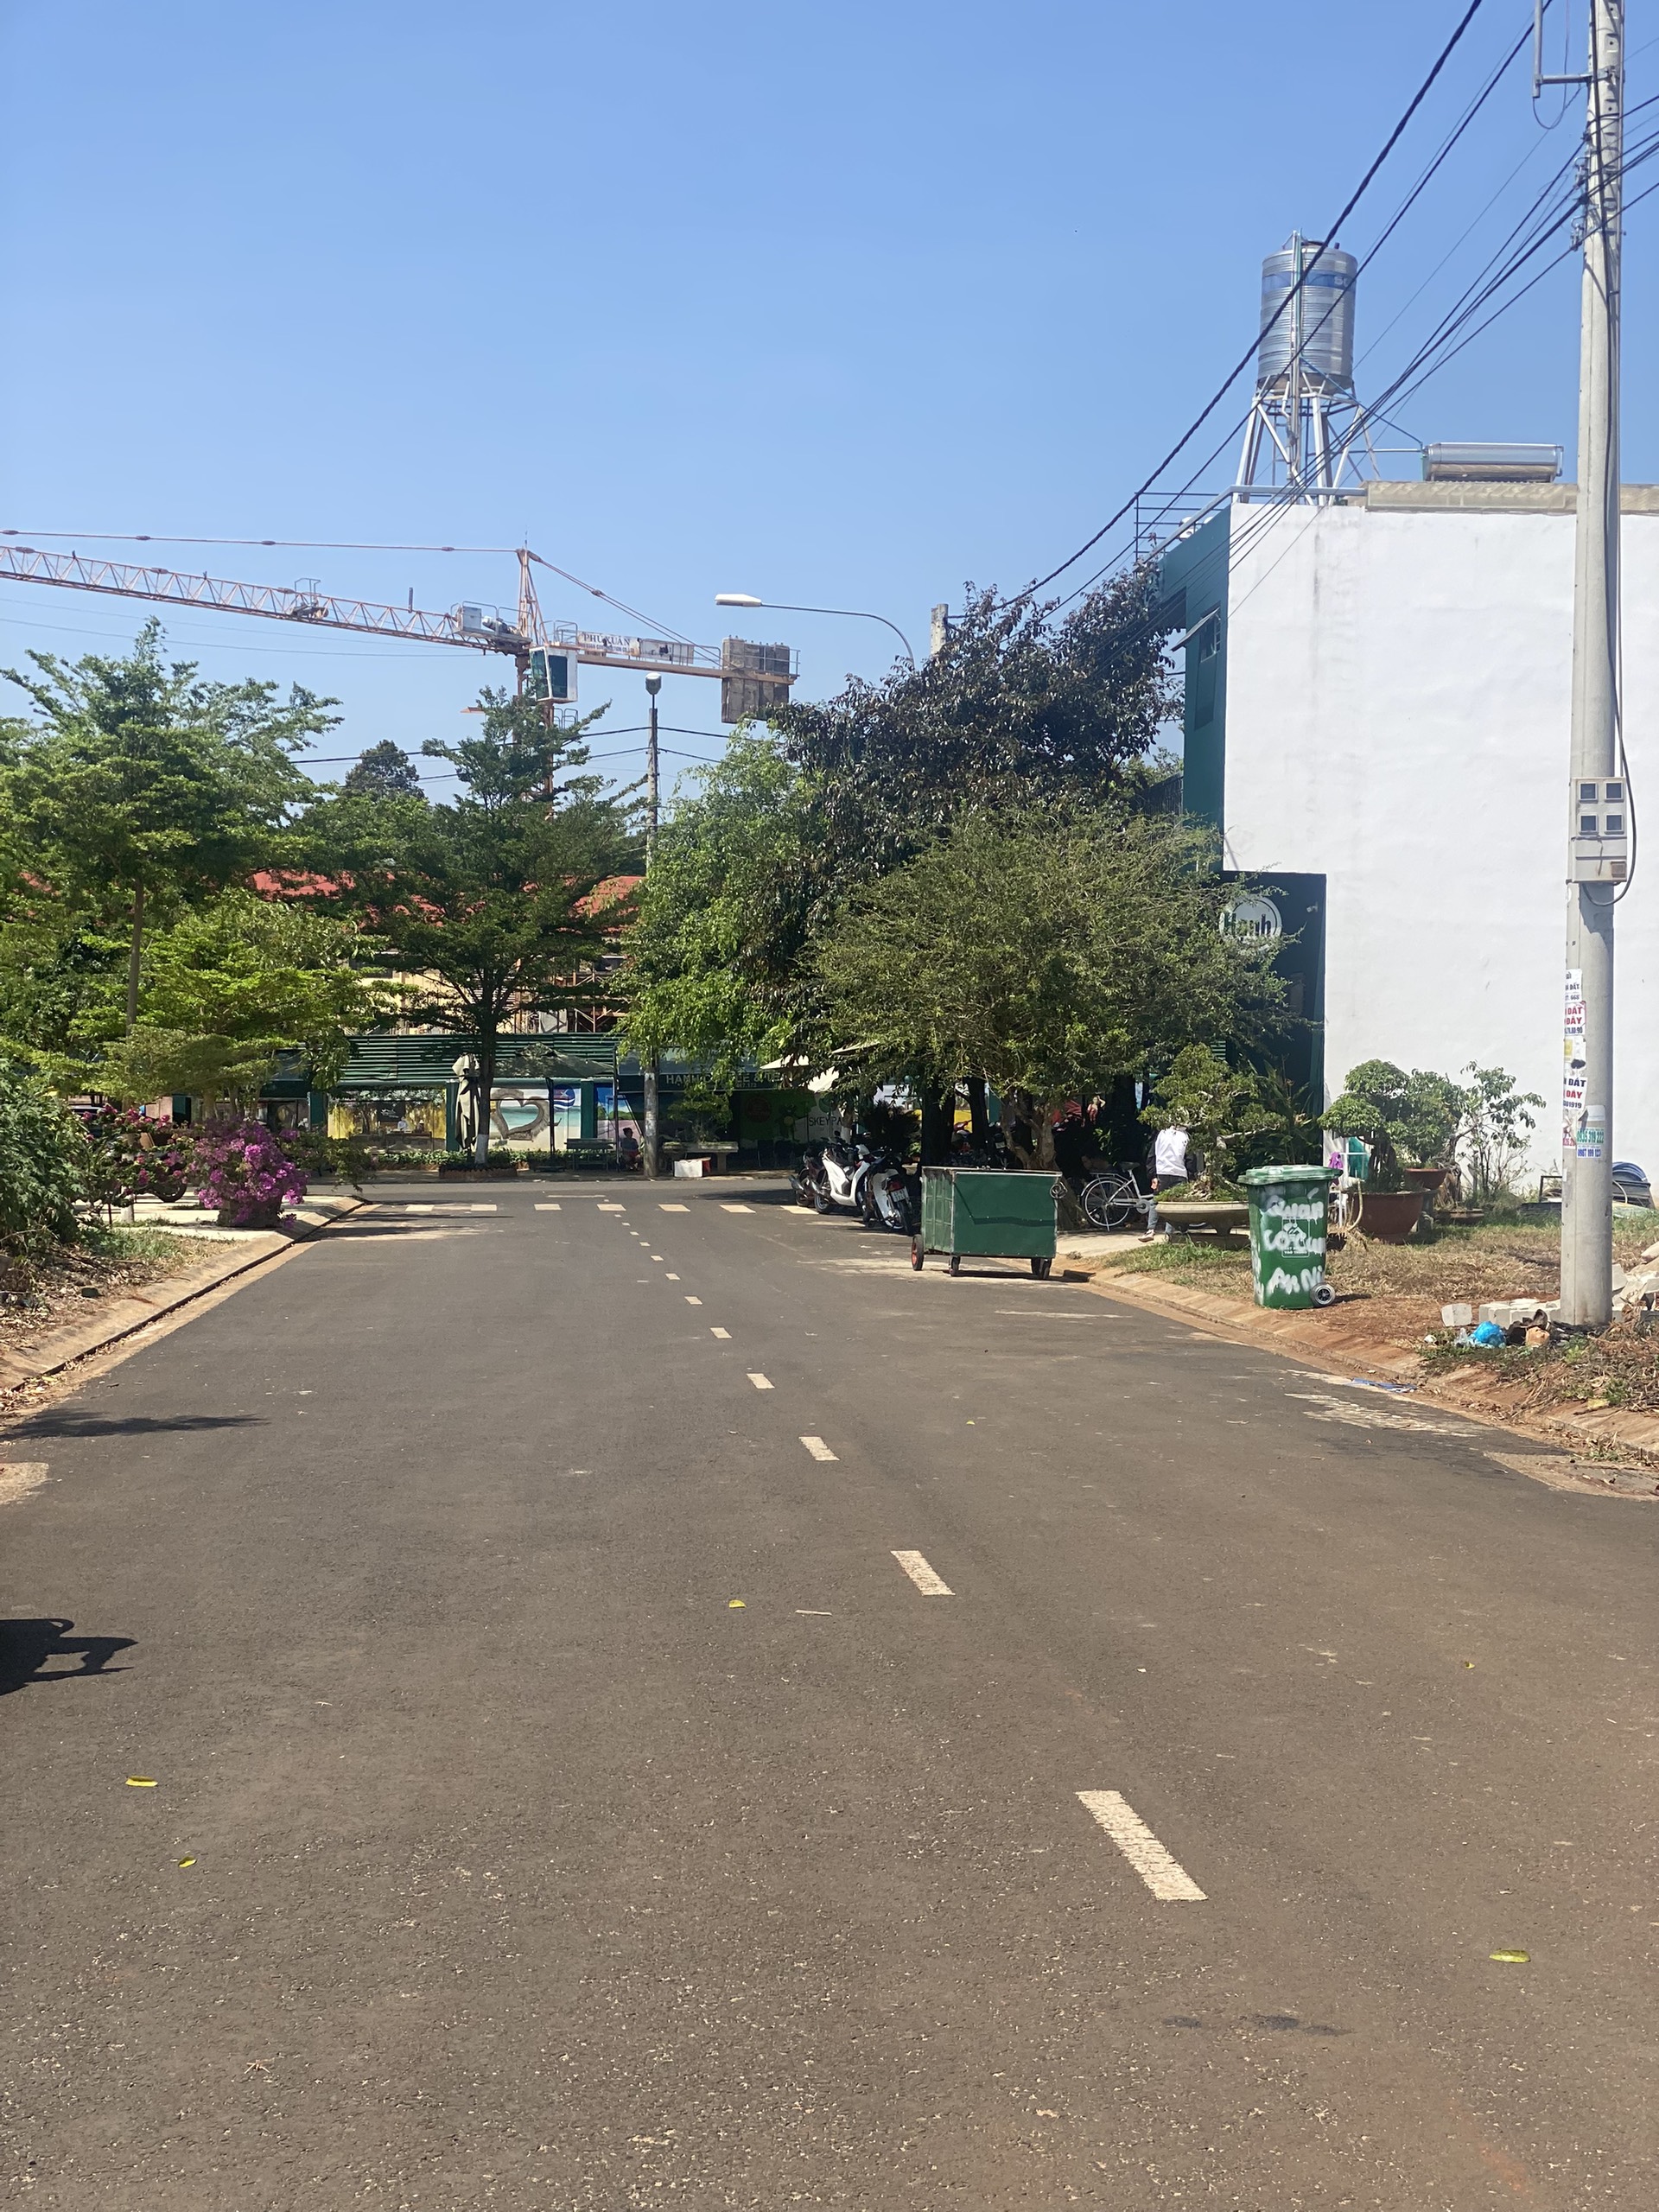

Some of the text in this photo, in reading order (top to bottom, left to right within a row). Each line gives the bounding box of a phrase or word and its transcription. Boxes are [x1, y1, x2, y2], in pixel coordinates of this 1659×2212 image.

[583, 631, 630, 646] PHÚ XUÂN
[1567, 1005, 1582, 1015] ĐẤT
[1566, 1015, 1582, 1026] ĐÂY
[1568, 1077, 1586, 1087] ĐẤT
[1566, 1089, 1583, 1099] ĐÂY
